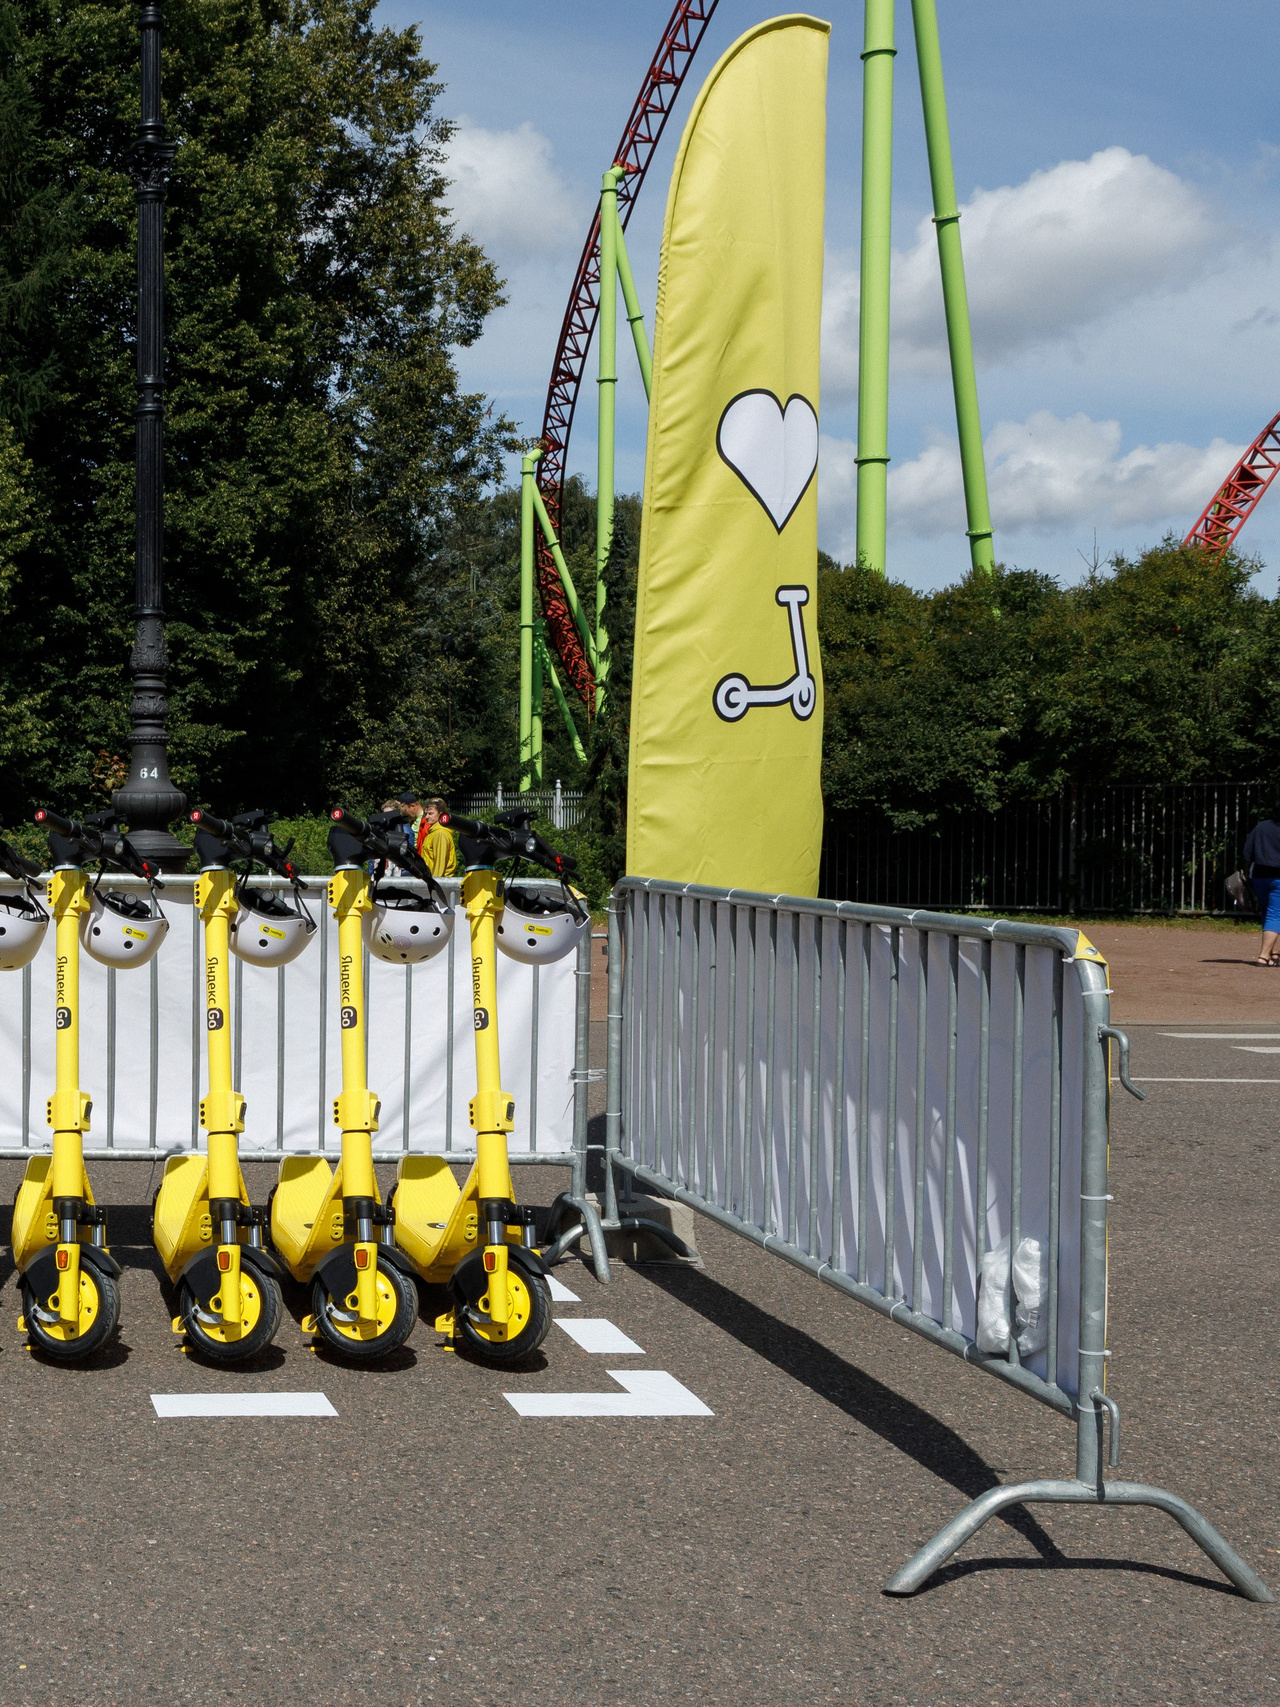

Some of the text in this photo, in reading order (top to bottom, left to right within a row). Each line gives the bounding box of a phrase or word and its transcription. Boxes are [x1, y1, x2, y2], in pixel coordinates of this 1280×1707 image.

[139, 767, 159, 779] 64
[56, 956, 68, 1028] Яндекс Go
[207, 957, 220, 1029] Яндекс Go
[340, 955, 354, 1027] Яндекс Go
[472, 957, 485, 1029] Яндекс Go
